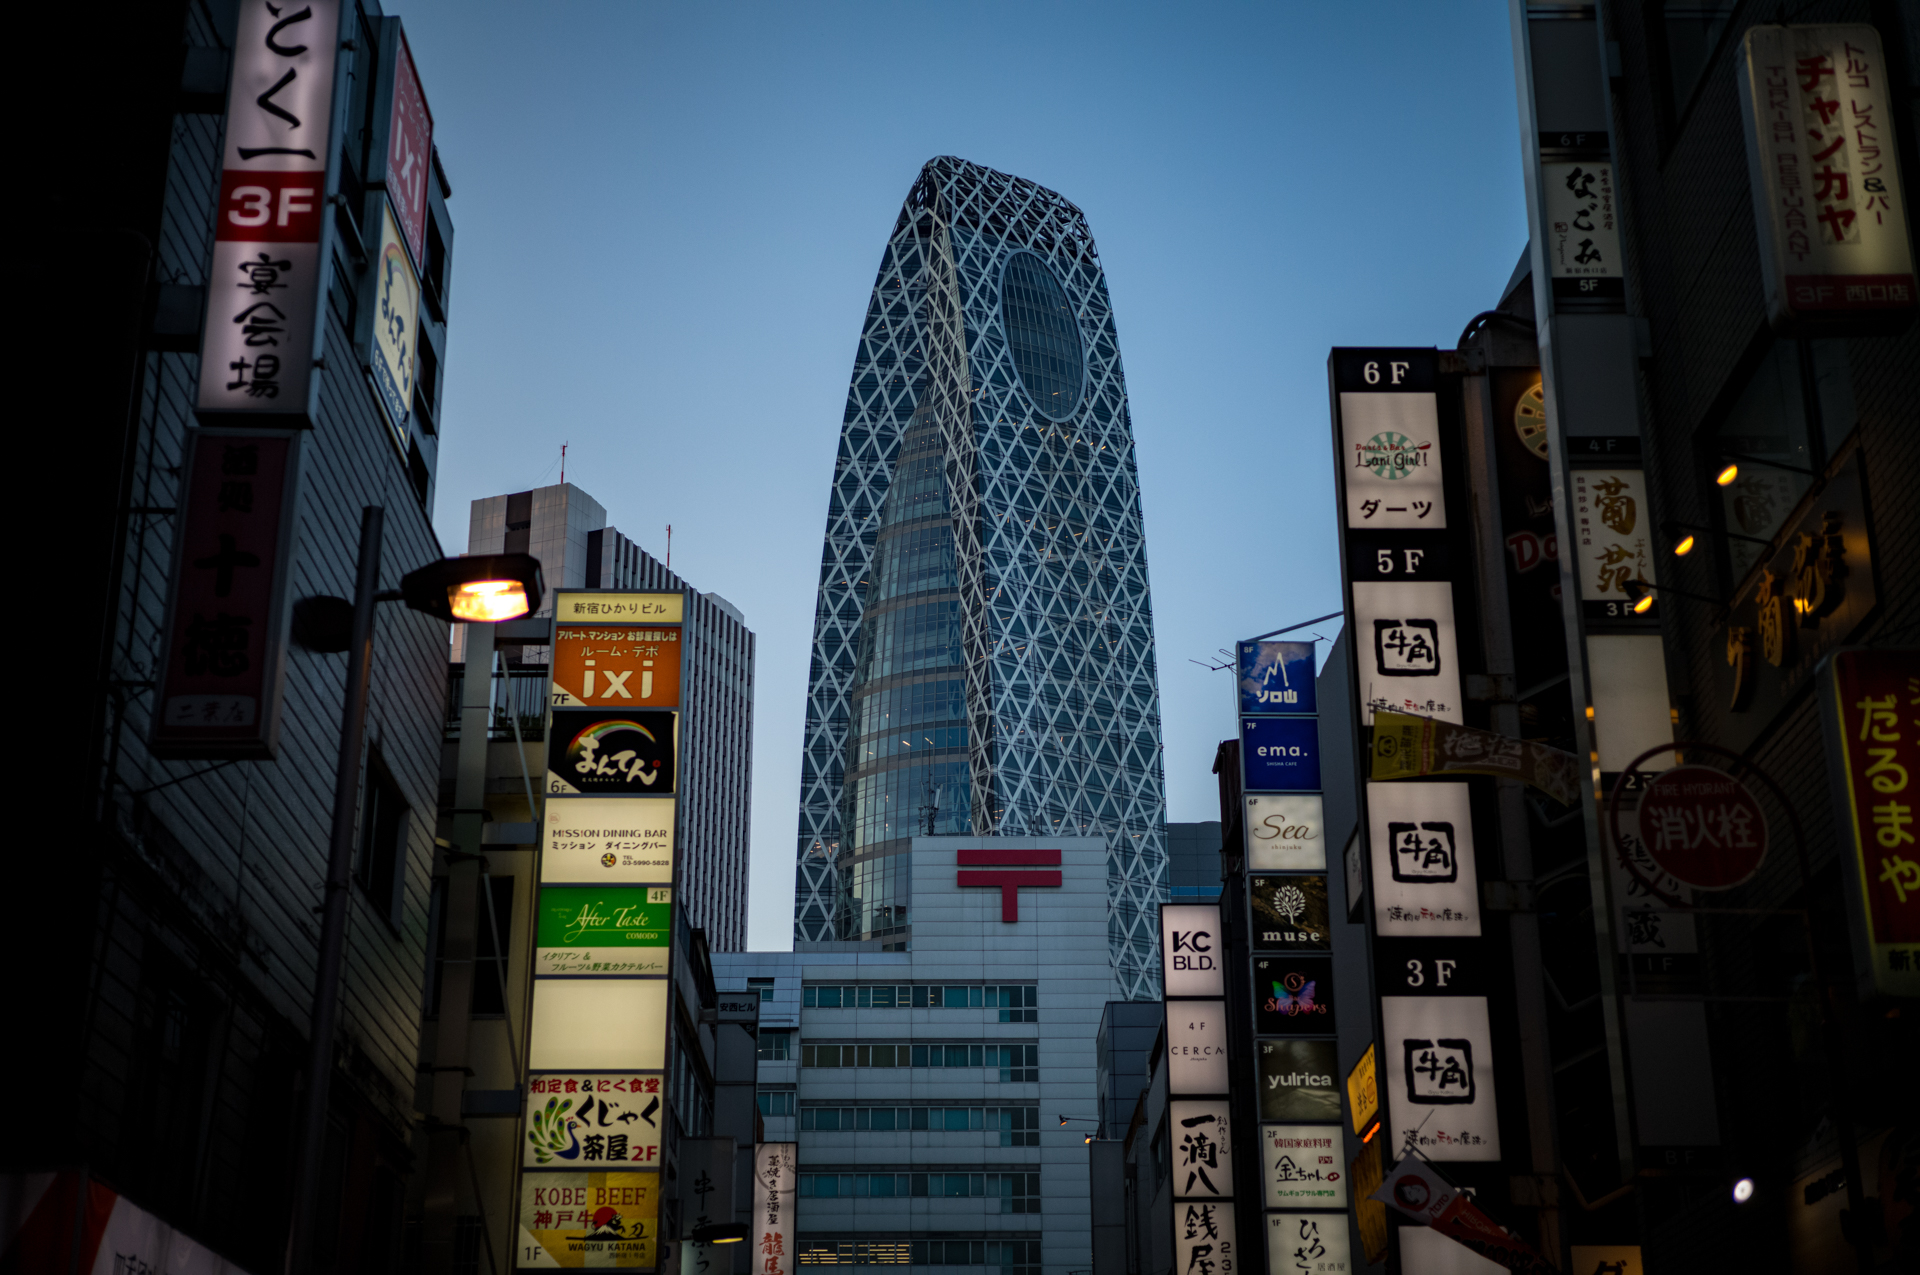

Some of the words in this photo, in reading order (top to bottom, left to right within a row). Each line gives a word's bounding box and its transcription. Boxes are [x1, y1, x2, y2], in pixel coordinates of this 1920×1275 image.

[1846, 41, 1869, 88] トルコ
[1765, 66, 1796, 143] TURKISH
[1560, 134, 1586, 146] 6F
[1796, 55, 1856, 242] チャンカヤ
[395, 101, 422, 212] ixi
[227, 185, 316, 228] 3F
[1566, 167, 1602, 264] なごみ
[1579, 279, 1598, 292] 5F
[1795, 285, 1835, 304] 3F
[1845, 284, 1910, 303] 西口店
[227, 253, 292, 399] 宴会場
[1363, 361, 1410, 385] 6F
[1588, 440, 1616, 452] 4F
[1356, 452, 1391, 468] Lani
[1361, 500, 1432, 519] ダーツ
[1377, 549, 1424, 574] 5F
[573, 602, 667, 614] 新宿ひかりビル
[1606, 603, 1634, 616] 3F
[626, 631, 677, 642] お部屋探しは
[581, 646, 659, 657] ルーム・デポ
[1384, 630, 1433, 662] 牛角
[582, 659, 654, 699] ixi
[553, 694, 569, 704] 7F
[1257, 746, 1308, 757] ema.
[575, 733, 658, 786] まんてん
[551, 780, 567, 793] 6F
[1654, 784, 1679, 796] FIRE
[1683, 783, 1736, 795] HYDRANT
[1856, 693, 1920, 903] だるまや
[603, 829, 641, 838] DINING
[644, 829, 667, 838] BAR
[1253, 815, 1318, 840] Sea
[1648, 803, 1758, 851] 消火栓
[552, 841, 596, 850] ミッション
[605, 841, 667, 850] ダイニングバー
[1399, 833, 1450, 868] 牛角
[651, 890, 668, 901] 4F
[563, 901, 611, 943] After
[613, 904, 650, 928] Taste
[626, 932, 658, 940] COMODO
[1173, 931, 1212, 952] KC
[1262, 931, 1320, 942] muse
[542, 953, 581, 961] イタリアン
[583, 952, 591, 961] &
[1174, 956, 1217, 970] BLD.
[1648, 957, 1673, 971] 1F
[551, 962, 663, 972] フルーツ&野菜カクテルバー
[1258, 961, 1269, 969] 4F
[1406, 959, 1456, 987] 3F
[720, 1003, 756, 1012] 安西ビル
[1171, 1046, 1224, 1055] CERCA
[1415, 1051, 1468, 1089] 牛角
[531, 1079, 660, 1093] 和定食&にく食堂
[1268, 1072, 1332, 1089] yulrica
[575, 1095, 660, 1129] くじゃく
[583, 1135, 628, 1161] 茶屋
[1274, 1138, 1332, 1148] 韓国家庭料理
[631, 1146, 657, 1161] 2F
[1664, 1151, 1695, 1165] BF
[1275, 1155, 1327, 1182] 金ちゃん
[534, 1188, 586, 1206] KOBE
[595, 1188, 647, 1206] BEEF
[533, 1210, 594, 1230] 神戸牛
[524, 1247, 542, 1261] 1F
[568, 1243, 603, 1251] WAGYU
[608, 1243, 645, 1251] KATANA
[1293, 1219, 1326, 1275] ひろさ
[1317, 1262, 1345, 1271] 居酒屋
